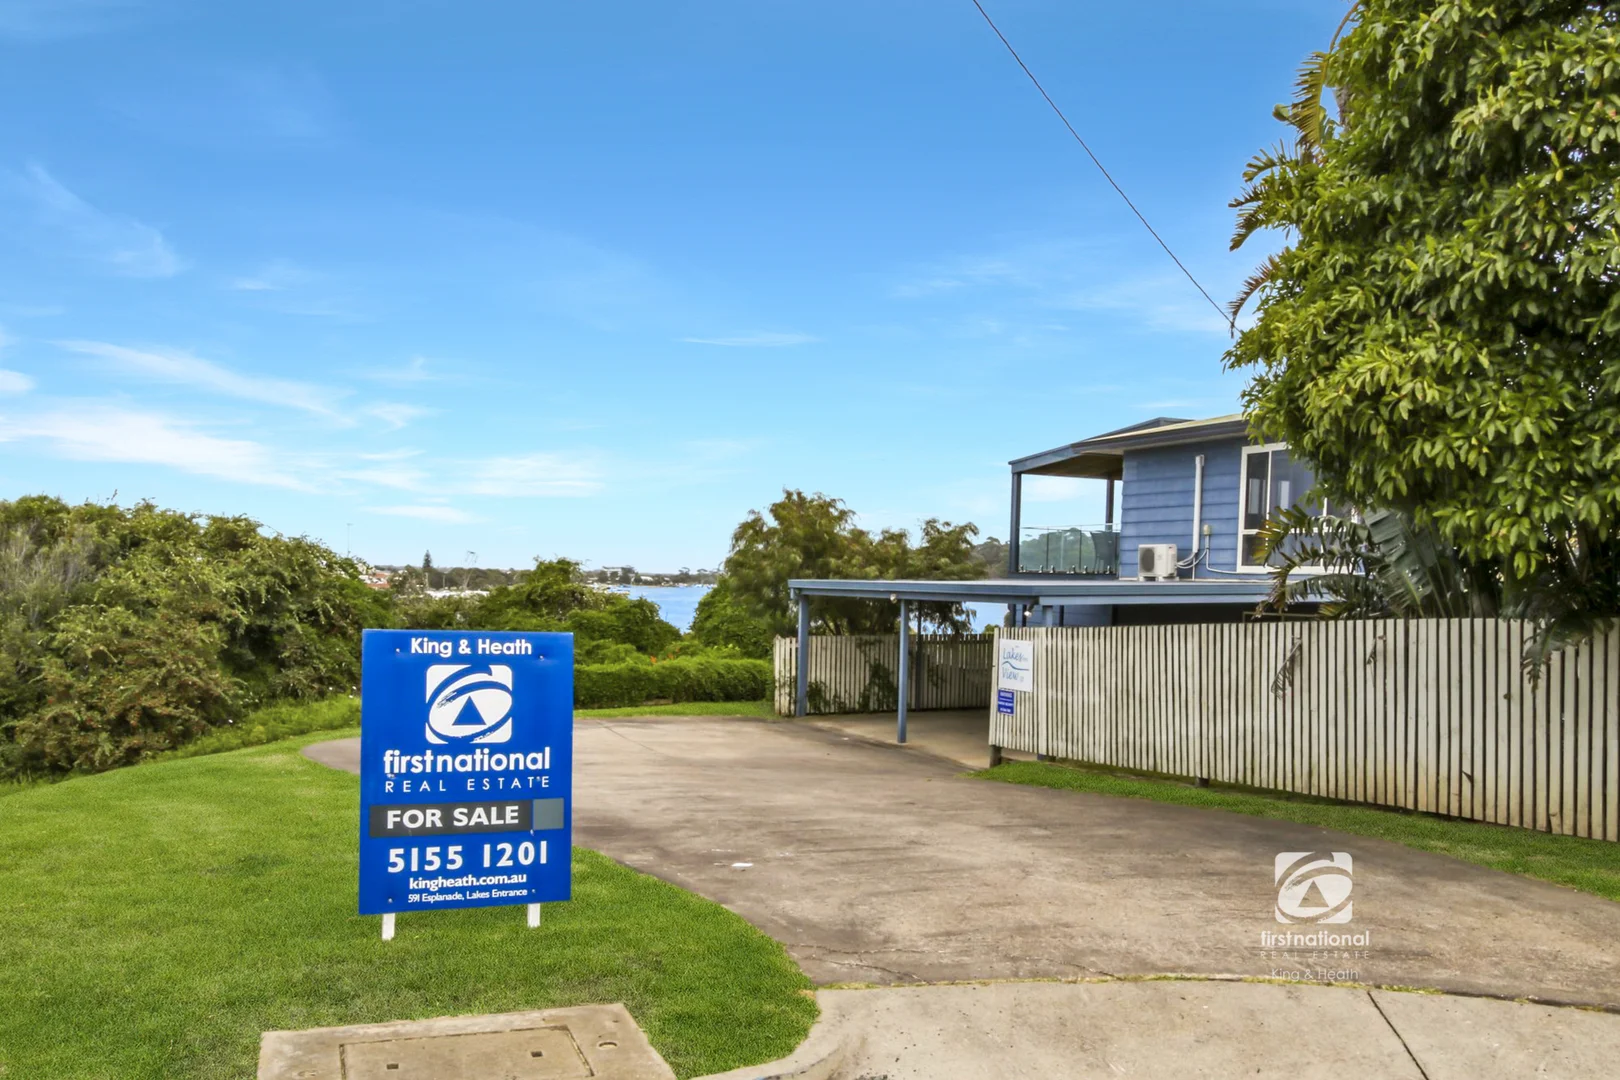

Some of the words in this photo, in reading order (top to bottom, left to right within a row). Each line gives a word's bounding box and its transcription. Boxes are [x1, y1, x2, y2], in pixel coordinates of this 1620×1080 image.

[411, 638, 452, 657] King
[459, 639, 472, 654] &
[478, 639, 532, 655] Heath
[385, 780, 447, 793] REAL
[467, 776, 549, 791] ESTATE
[387, 809, 443, 829] FOR
[453, 805, 519, 827] SALE
[387, 845, 464, 873] 5155
[483, 840, 548, 868] 1201
[409, 874, 527, 892] kingheath.com.au
[408, 893, 420, 903] 591
[422, 893, 465, 904] Esplanade,
[466, 890, 490, 900] Lakes
[492, 888, 528, 898] Entrance
